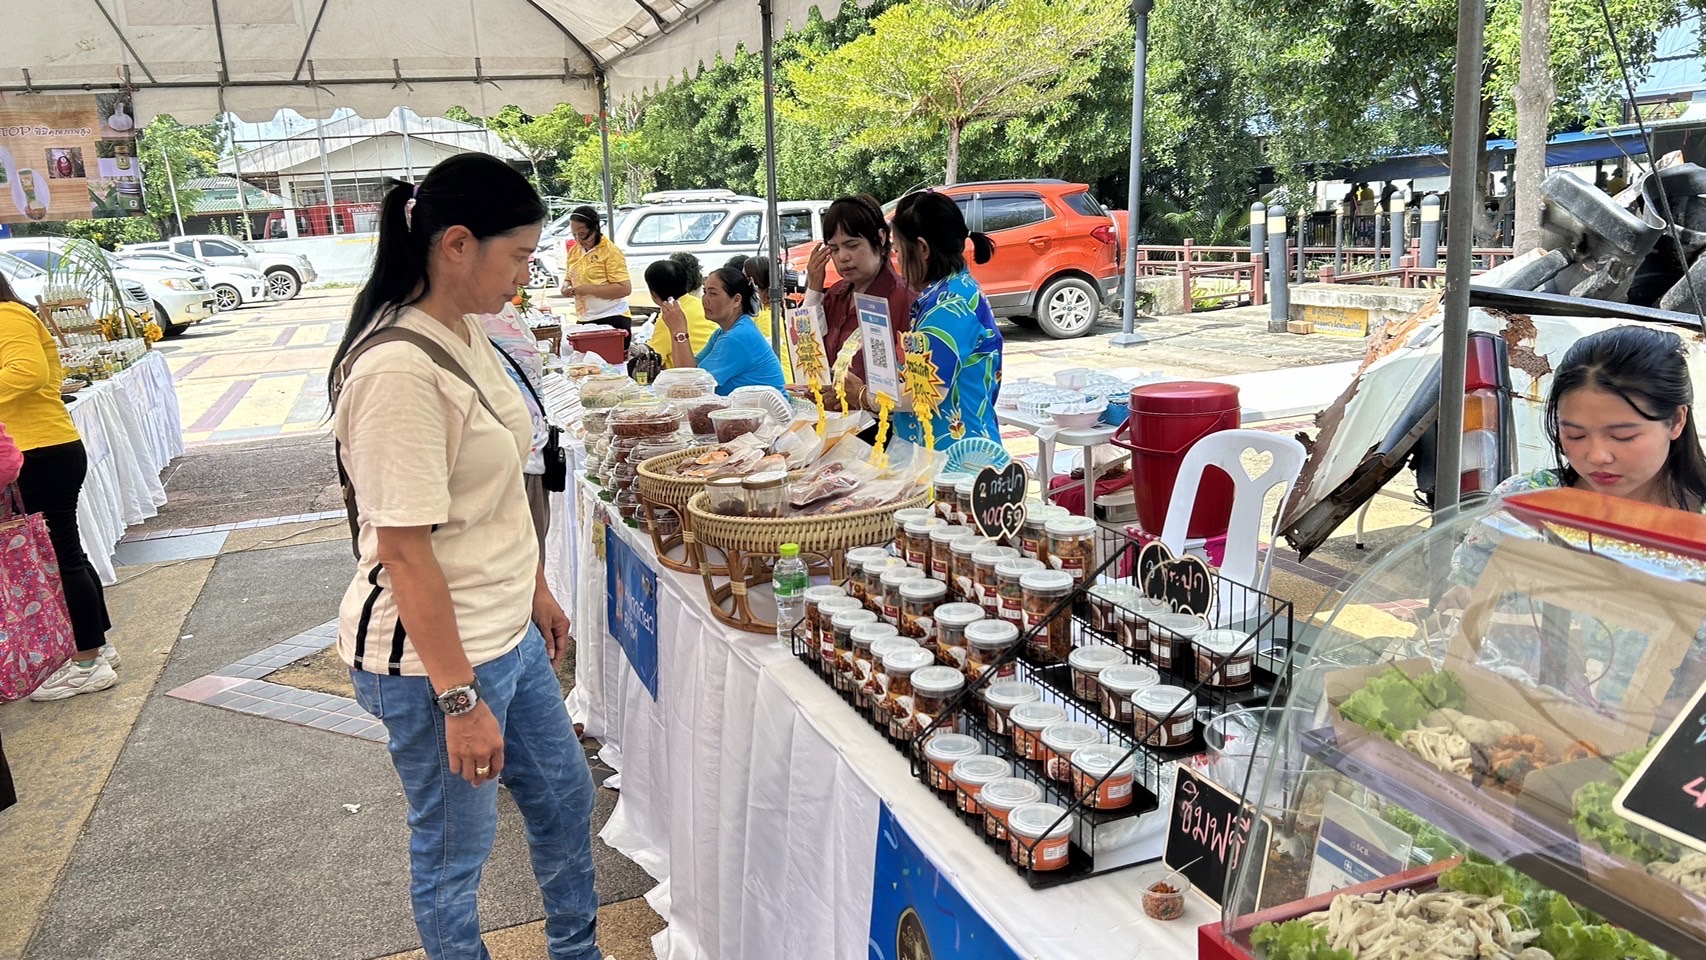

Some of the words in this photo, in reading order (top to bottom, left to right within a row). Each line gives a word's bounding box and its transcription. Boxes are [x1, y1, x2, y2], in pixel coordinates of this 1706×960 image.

[979, 482, 987, 498] 2
[990, 464, 1023, 500] กระปุก
[982, 506, 1002, 526] 100
[1006, 509, 1021, 527] 59
[1164, 565, 1204, 603] ระปุก
[1181, 780, 1251, 870] ชิมฟรี
[1356, 844, 1369, 856] SCB
